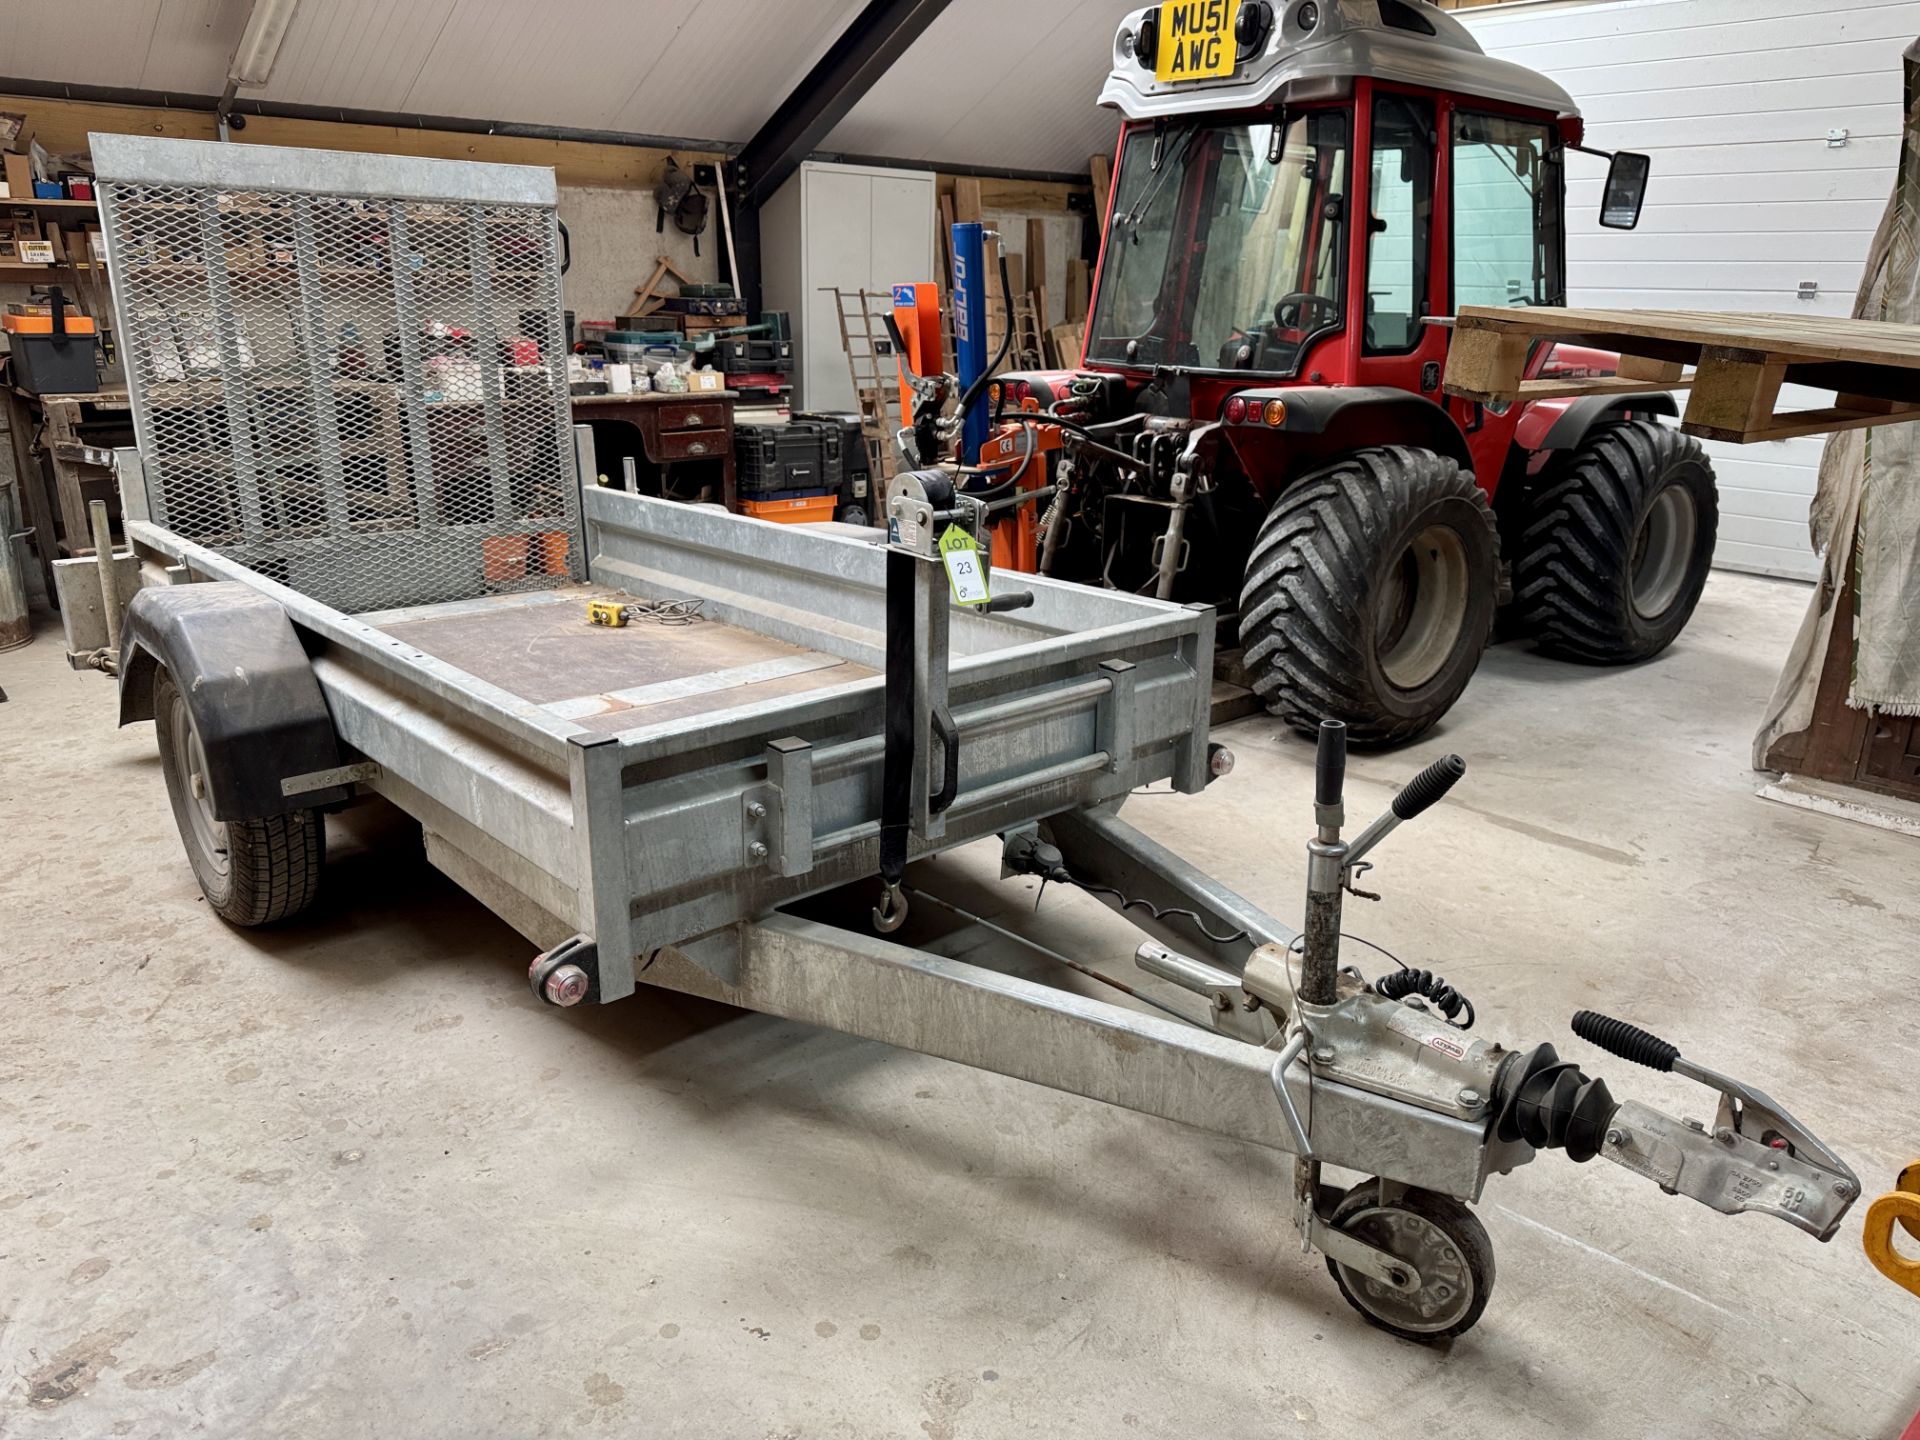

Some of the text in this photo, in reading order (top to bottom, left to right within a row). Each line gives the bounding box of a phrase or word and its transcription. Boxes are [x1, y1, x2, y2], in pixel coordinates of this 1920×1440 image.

[1172, 0, 1229, 37] MU51
[1171, 37, 1222, 73] AWG
[945, 537, 969, 550] LOT
[957, 561, 973, 575] 23
